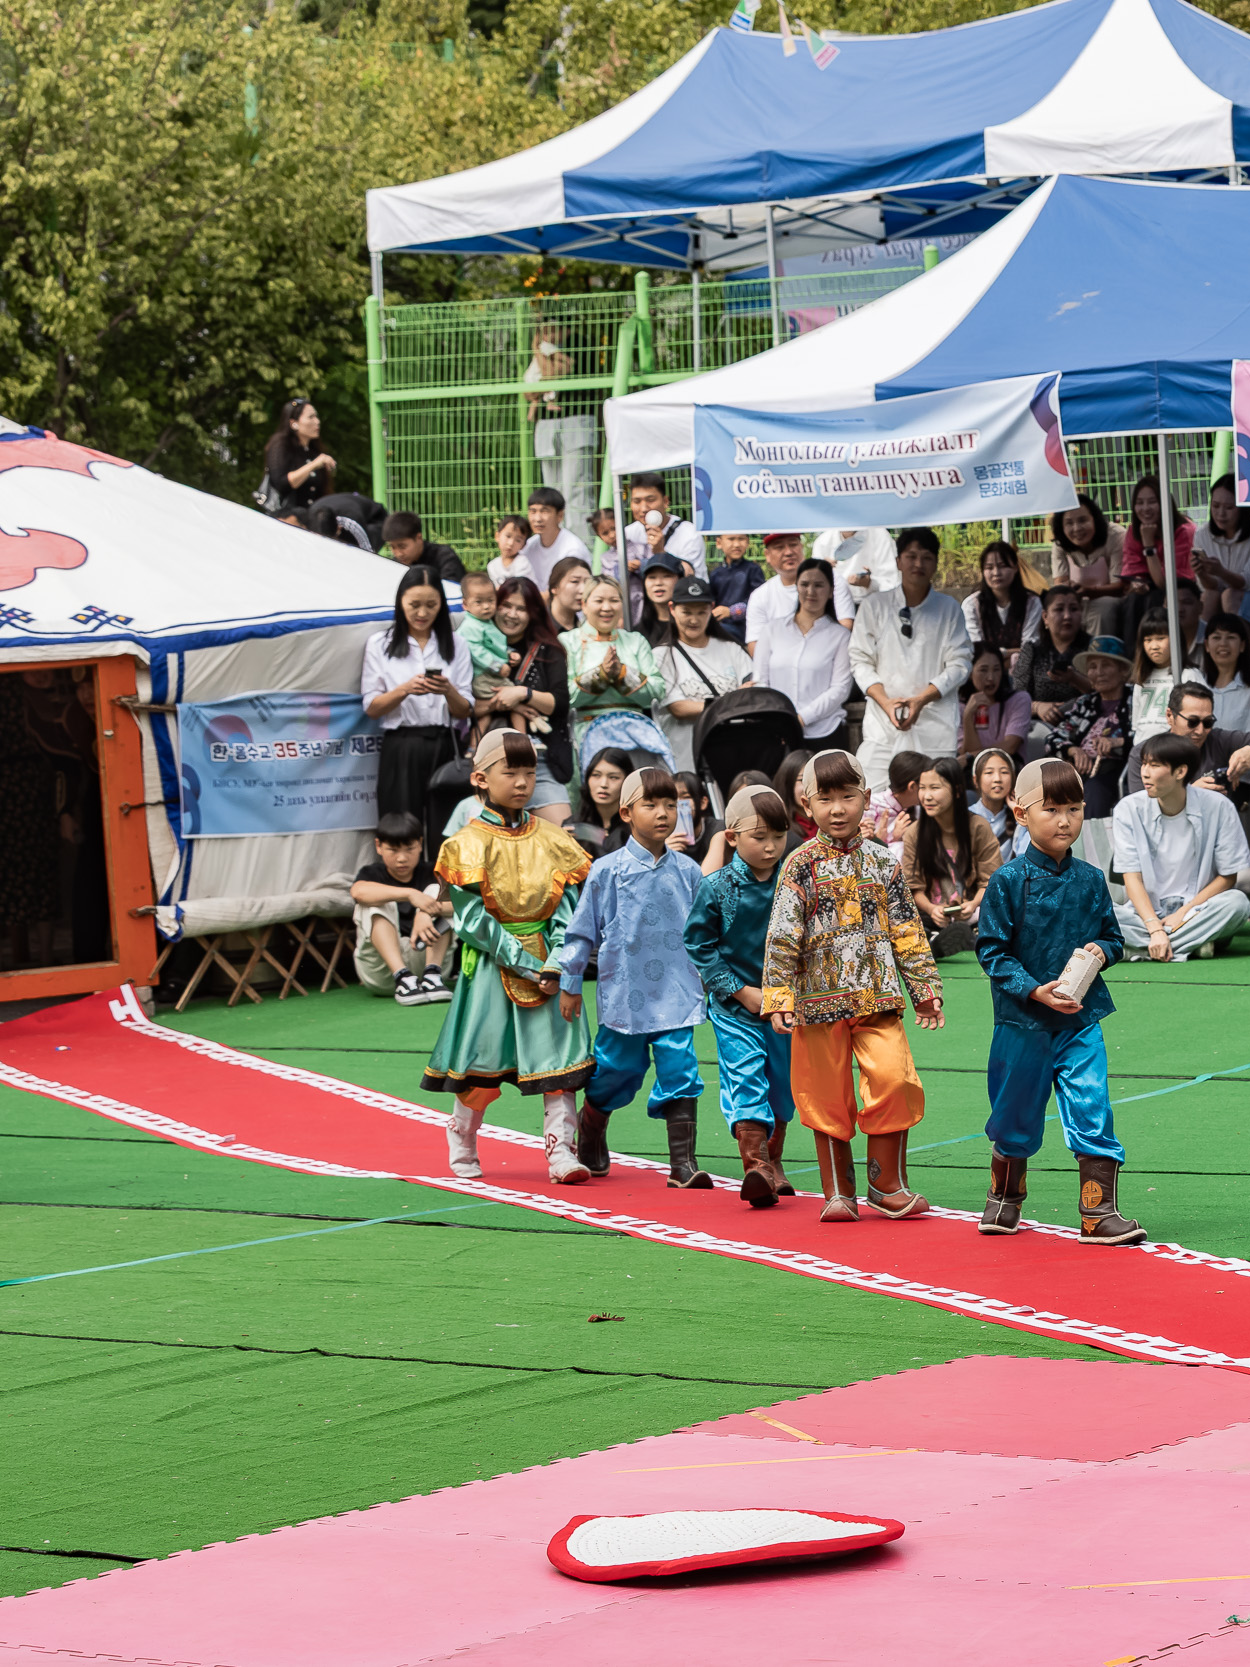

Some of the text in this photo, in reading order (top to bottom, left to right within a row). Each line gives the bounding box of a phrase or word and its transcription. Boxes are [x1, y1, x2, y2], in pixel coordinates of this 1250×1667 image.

[735, 432, 978, 465] Монголын уламжлалт
[737, 468, 962, 495] соёлын танилцуулга
[973, 460, 1025, 481] 몽골전통
[979, 479, 1028, 498] 문화체험
[1141, 686, 1169, 718] 74
[274, 741, 323, 758] 35주년
